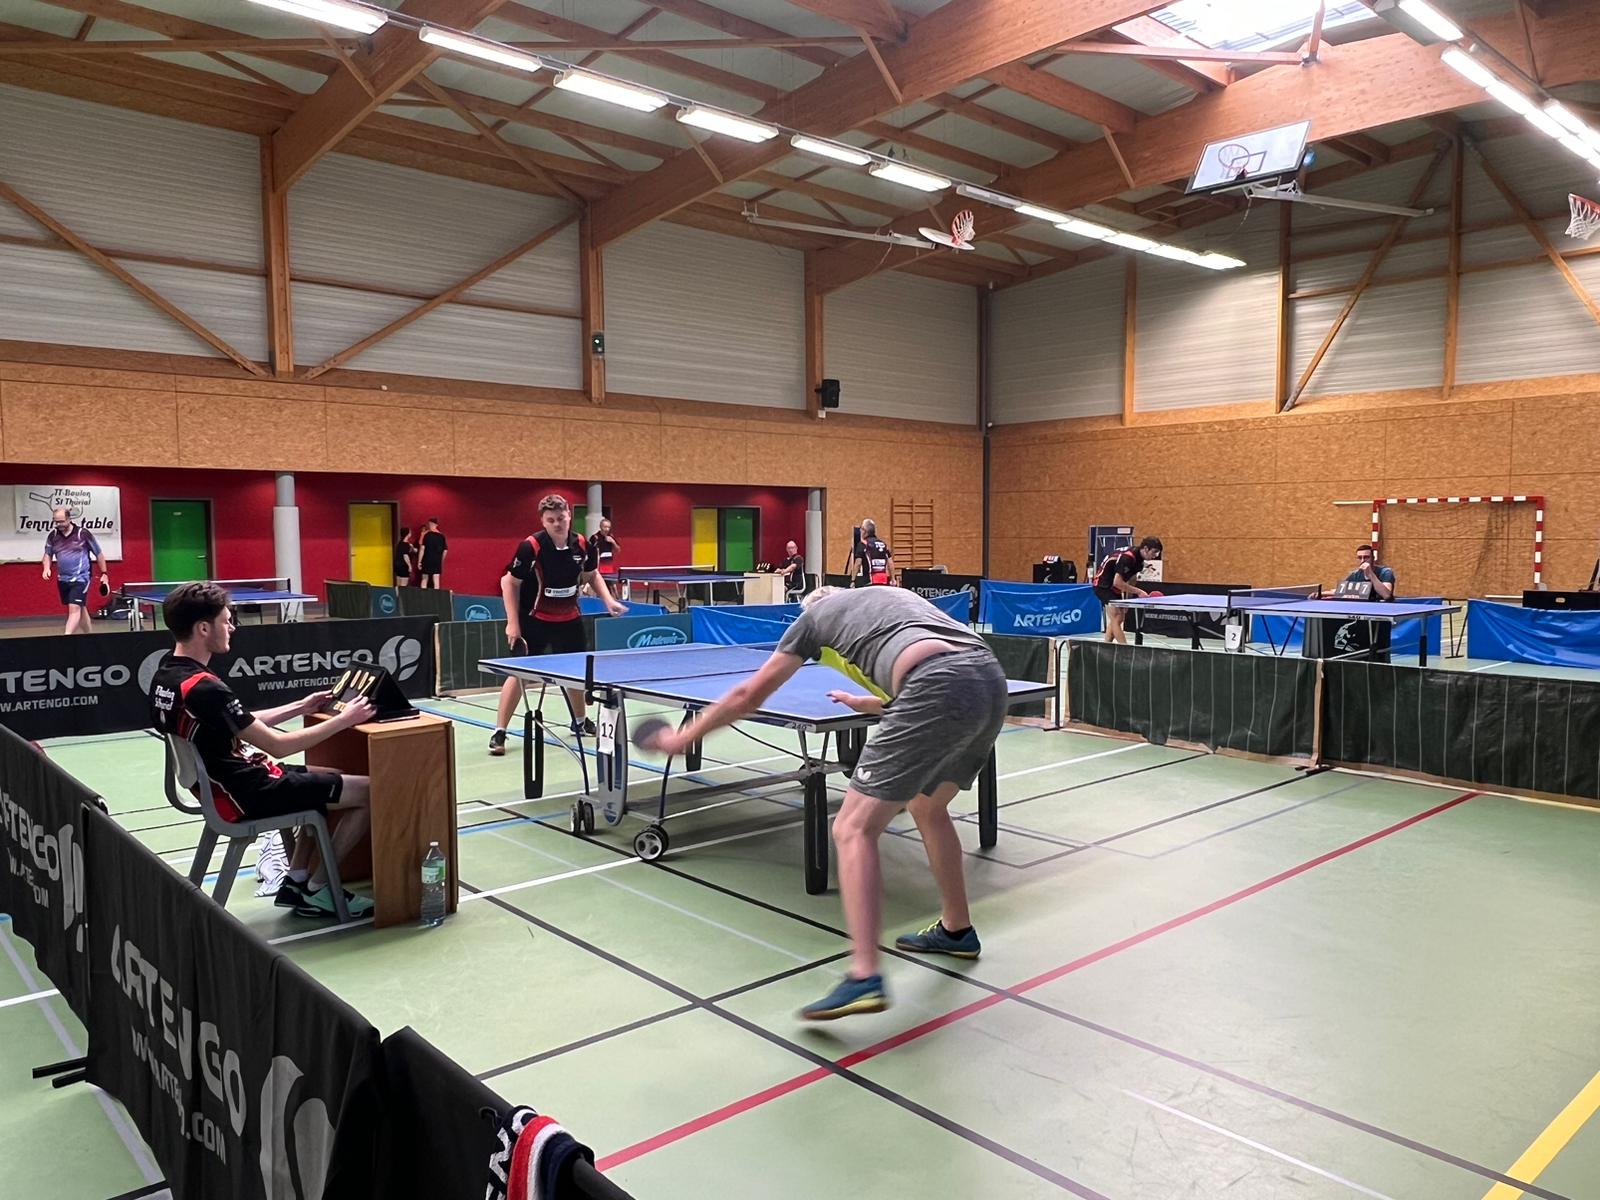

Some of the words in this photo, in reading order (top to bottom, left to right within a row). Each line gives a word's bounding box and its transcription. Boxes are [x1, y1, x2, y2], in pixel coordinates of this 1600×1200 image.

[19, 515, 54, 531] Tenni
[81, 517, 114, 529] table
[1013, 608, 1082, 627] ARTENGO
[1231, 632, 1237, 641] 2
[228, 648, 374, 678] ARTENGO
[602, 722, 614, 739] 12
